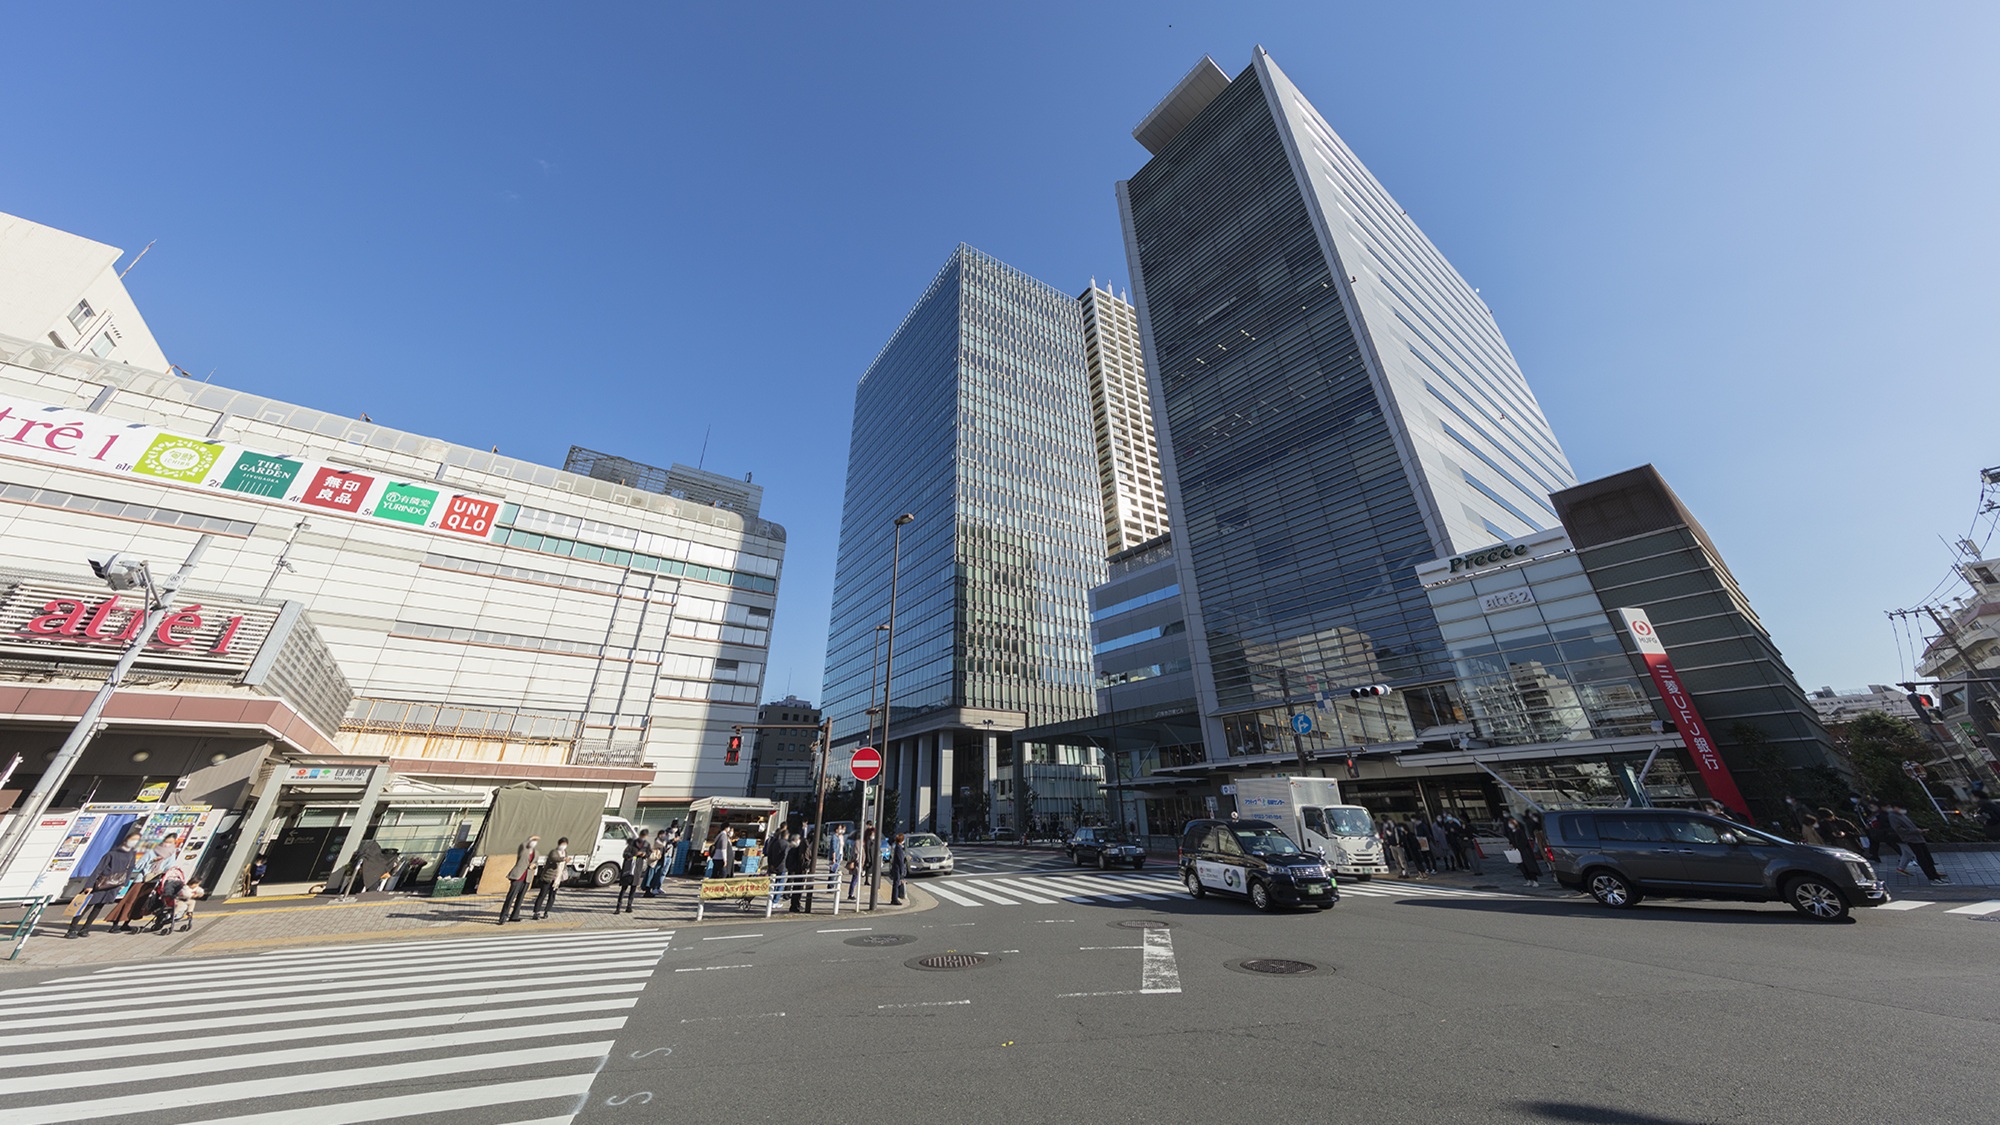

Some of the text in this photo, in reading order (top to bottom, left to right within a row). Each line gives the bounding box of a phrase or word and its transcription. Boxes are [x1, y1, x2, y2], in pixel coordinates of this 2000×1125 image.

[115, 463, 134, 472] B1F
[239, 463, 292, 479] GARDEN
[257, 459, 283, 471] THE
[207, 478, 221, 488] 2F
[323, 475, 361, 492] 無印
[315, 488, 352, 505] 良品
[383, 500, 427, 516] YURINDO
[453, 499, 490, 518] UNI
[447, 514, 487, 532] QLO
[1449, 544, 1528, 573] Precce
[1656, 664, 1719, 770] 三菱UFJ銀行
[335, 768, 367, 777] 目黒駅
